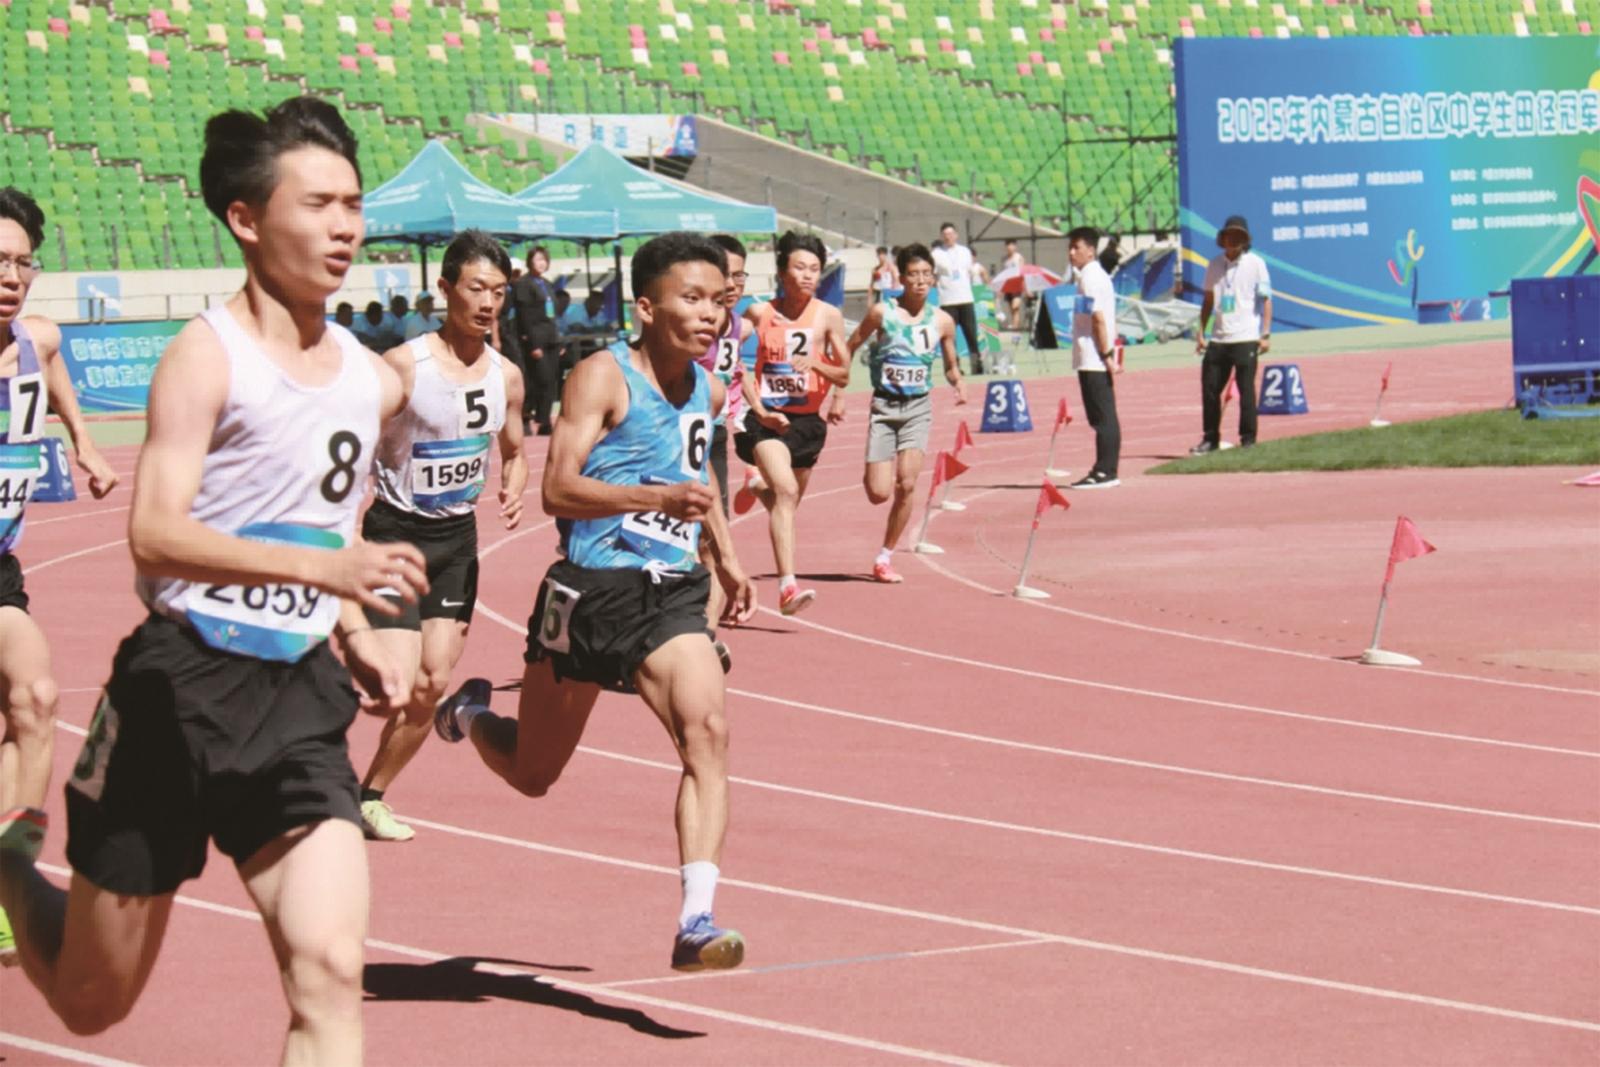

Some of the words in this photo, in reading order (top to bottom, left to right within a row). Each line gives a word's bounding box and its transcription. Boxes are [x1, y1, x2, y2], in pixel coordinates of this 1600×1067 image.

[791, 331, 808, 356] 2
[920, 327, 930, 350] 1
[718, 341, 733, 372] 3
[1265, 368, 1283, 396] 2
[1288, 367, 1302, 395] 2
[19, 380, 39, 435] 7
[465, 389, 489, 429] 5
[990, 384, 1008, 413] 3
[1013, 383, 1026, 412] 3
[688, 419, 707, 471] 6
[320, 430, 362, 503] 8
[421, 457, 482, 488] 1599
